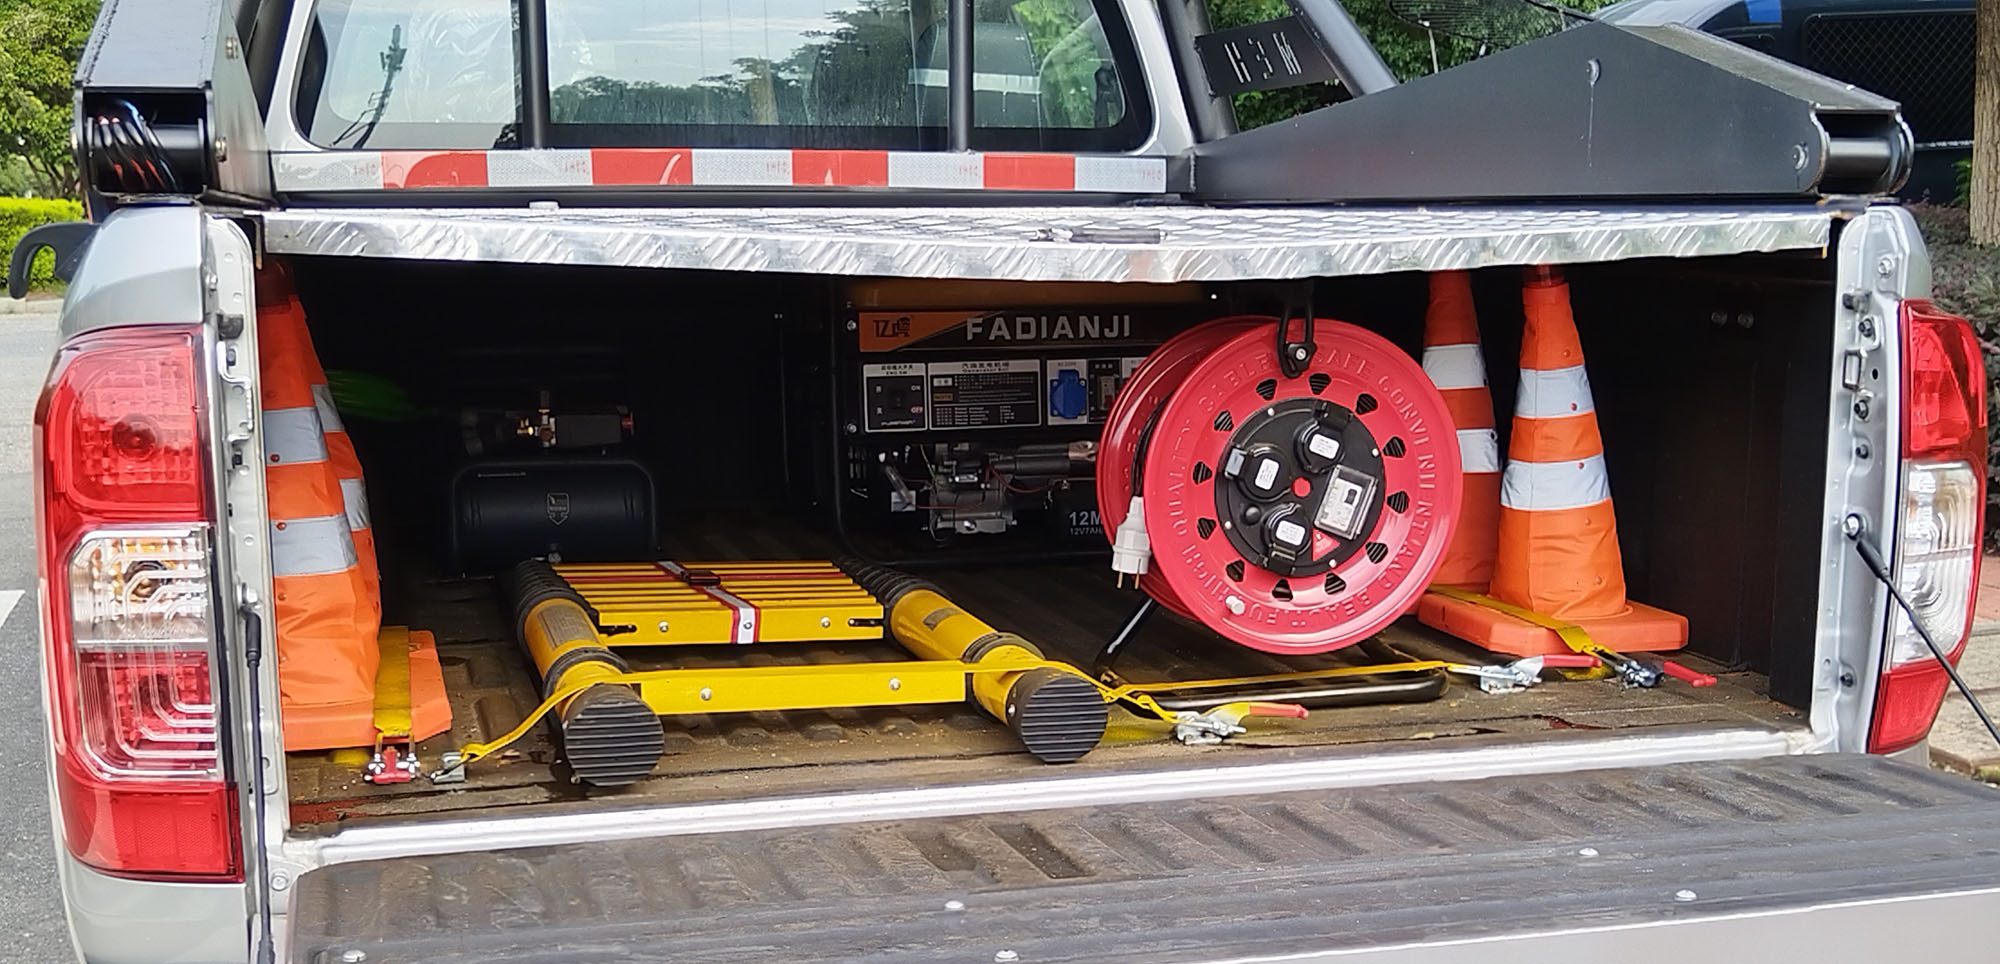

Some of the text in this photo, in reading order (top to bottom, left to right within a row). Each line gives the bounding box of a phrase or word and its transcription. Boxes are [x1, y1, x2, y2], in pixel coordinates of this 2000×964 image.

[966, 314, 1131, 341] FADIANJI
[1198, 351, 1275, 412] CABLE
[1239, 587, 1372, 627] BEAUTIFU
